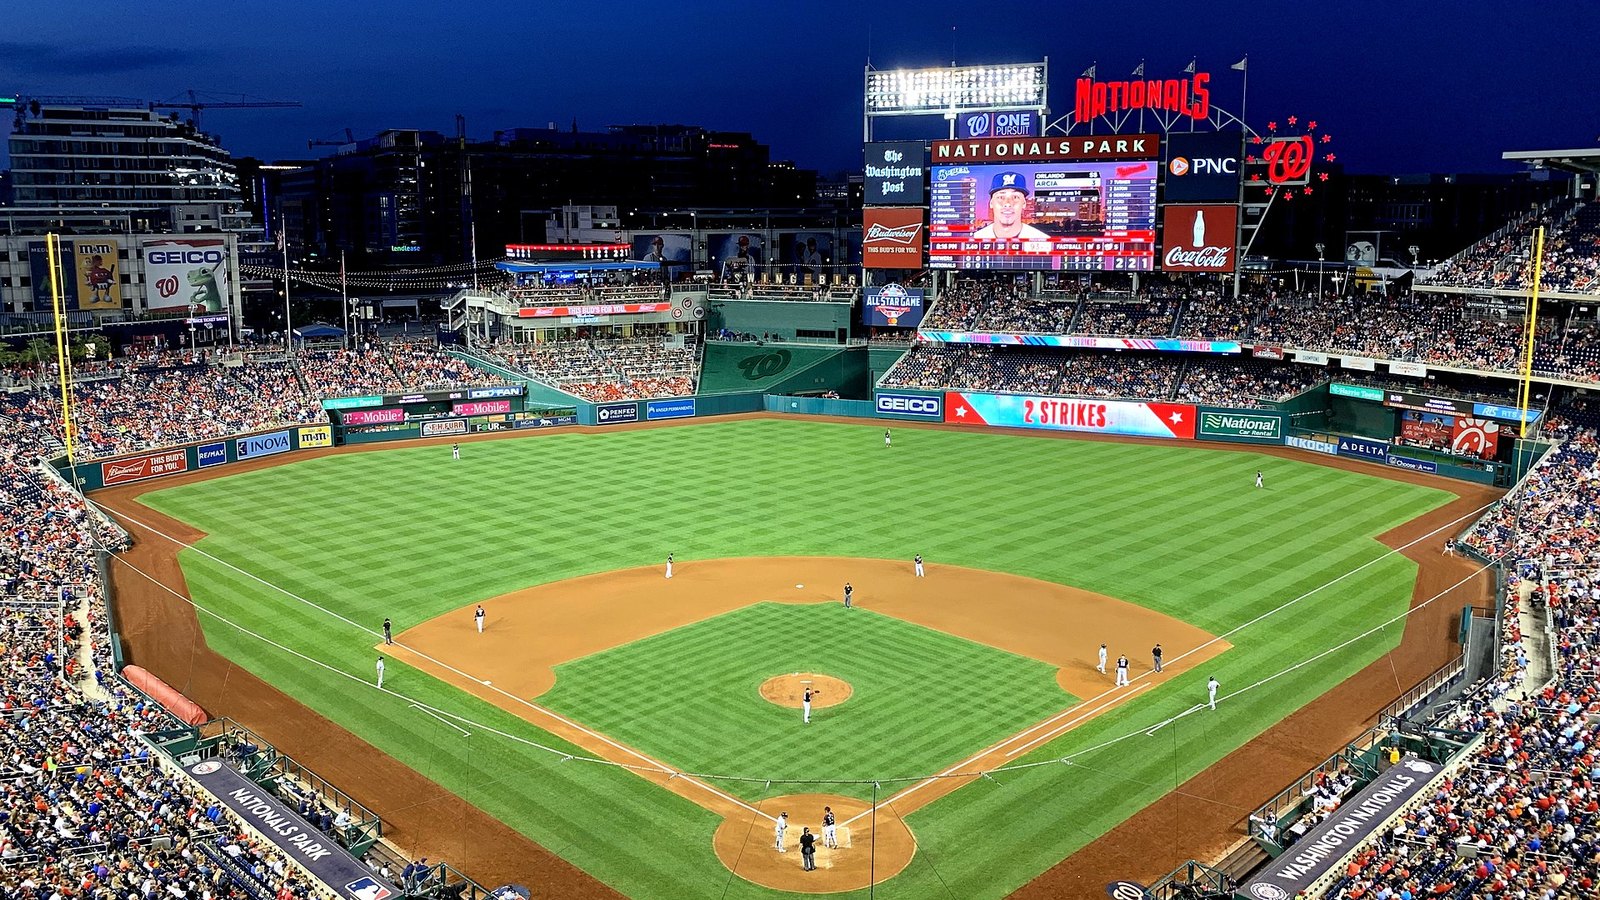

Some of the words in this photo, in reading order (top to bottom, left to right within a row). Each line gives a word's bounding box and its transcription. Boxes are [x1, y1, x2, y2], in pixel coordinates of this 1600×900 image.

[1075, 72, 1210, 122] NATIONALS
[996, 114, 1030, 126] ONE
[996, 126, 1030, 136] PURSUIT
[938, 141, 1070, 158] NATIONALS
[1084, 138, 1145, 154] PARK
[884, 150, 902, 162] The
[1264, 135, 1314, 183] W
[866, 164, 922, 178] Washington
[1192, 158, 1236, 174] PNC
[882, 181, 904, 196] Post
[868, 228, 916, 238] Budweiser
[148, 250, 220, 264] GEICO
[1116, 258, 1123, 268] 2
[1128, 257, 1136, 268] 2
[1142, 258, 1148, 268] 1
[734, 272, 798, 286] SWING
[819, 273, 856, 286] BIG
[156, 275, 179, 298] W
[866, 296, 880, 306] ALL
[880, 297, 900, 306] STAR
[900, 297, 920, 306] GAME
[1074, 338, 1097, 347] STRIKES
[1186, 341, 1211, 351] STRIKES
[879, 398, 938, 412] GEICO
[1024, 400, 1034, 423] 2
[1040, 401, 1106, 428] STRIKES
[1221, 414, 1276, 430] National
[251, 436, 288, 452] INOVA
[1300, 438, 1333, 454] KOCH
[1351, 442, 1384, 456] DELTA
[166, 453, 184, 462] BUD'S
[200, 449, 224, 459] RE/MAX
[110, 466, 142, 476] Budweiser
[151, 465, 164, 473] FOR
[164, 463, 179, 471] YOU.
[1396, 460, 1415, 470] Choose
[229, 788, 299, 836] NATIONALS
[288, 832, 331, 862] PARK
[1277, 816, 1360, 880] WASHINGTON
[1354, 774, 1415, 826] NATIONALS
